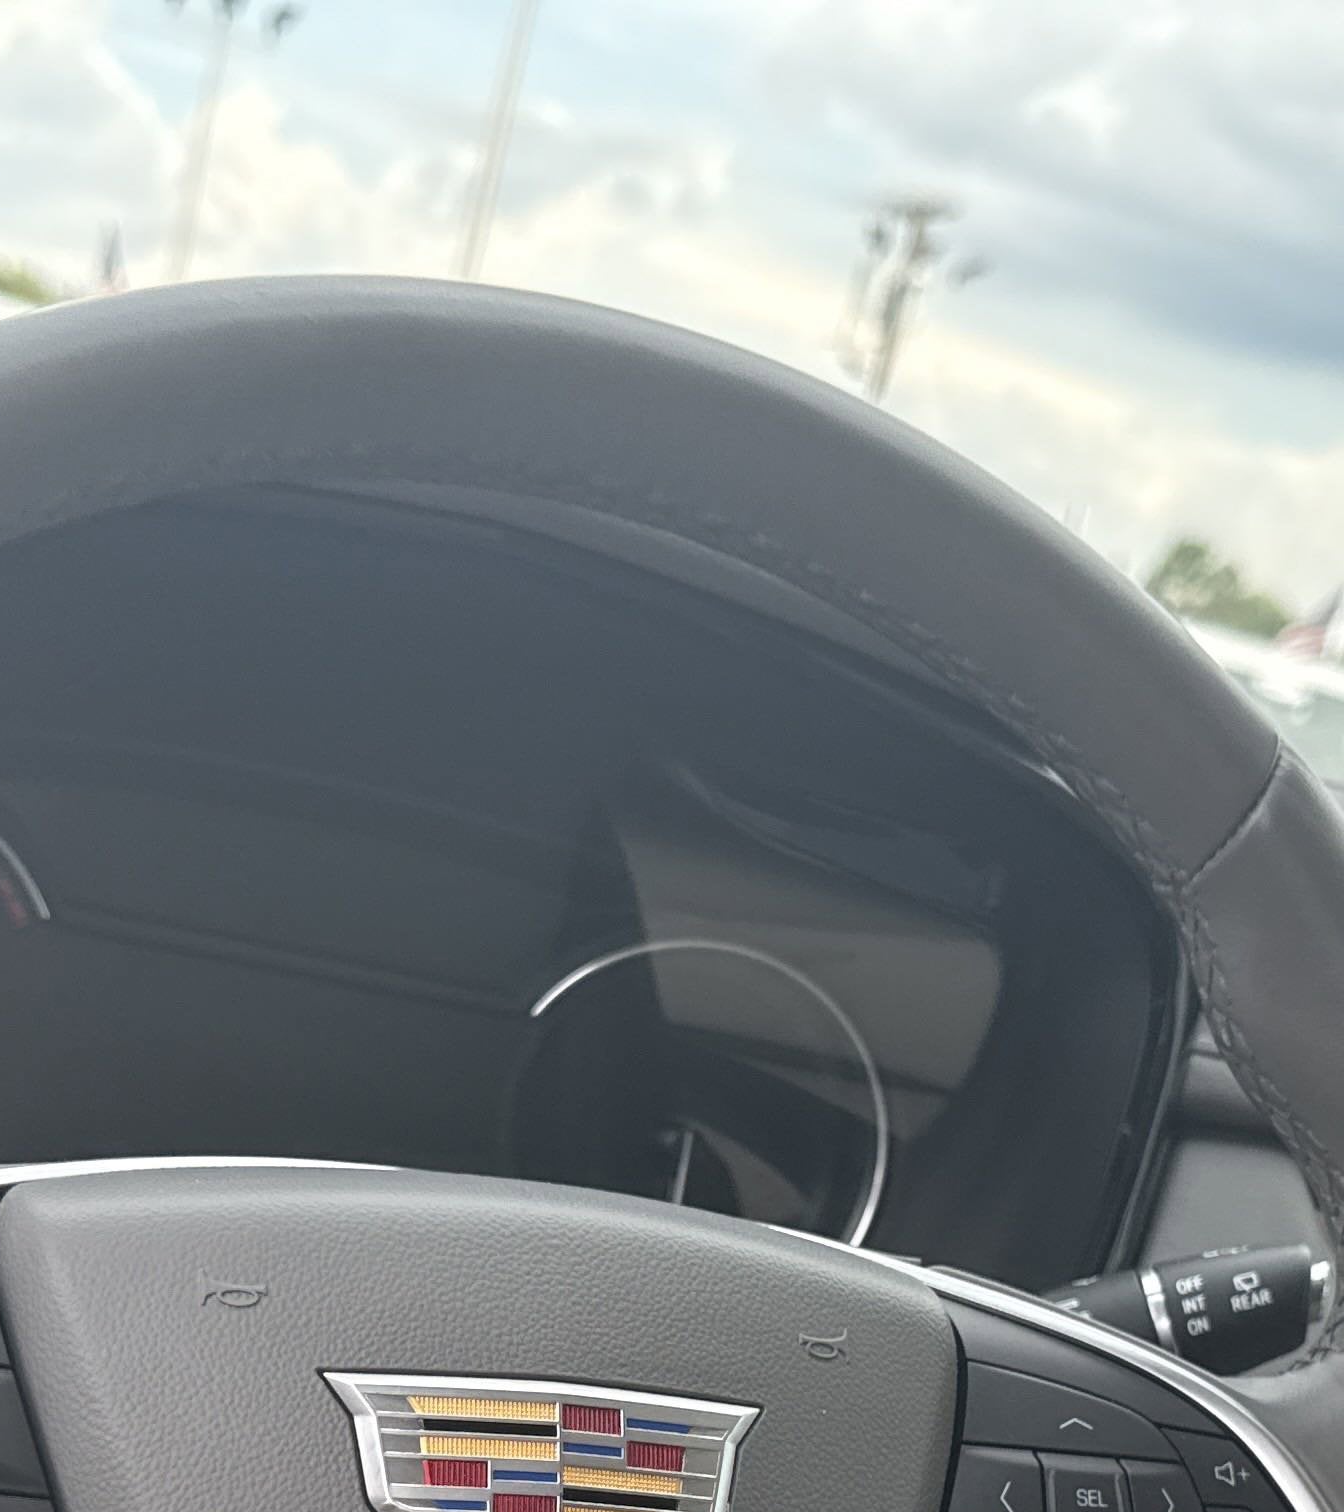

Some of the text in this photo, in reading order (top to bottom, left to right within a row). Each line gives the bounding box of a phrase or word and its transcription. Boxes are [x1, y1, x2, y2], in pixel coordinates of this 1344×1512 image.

[1175, 1273, 1203, 1295] OFF
[1229, 1287, 1274, 1313] REAR
[1186, 1315, 1210, 1337] ON
[1076, 1488, 1109, 1508] SEL
